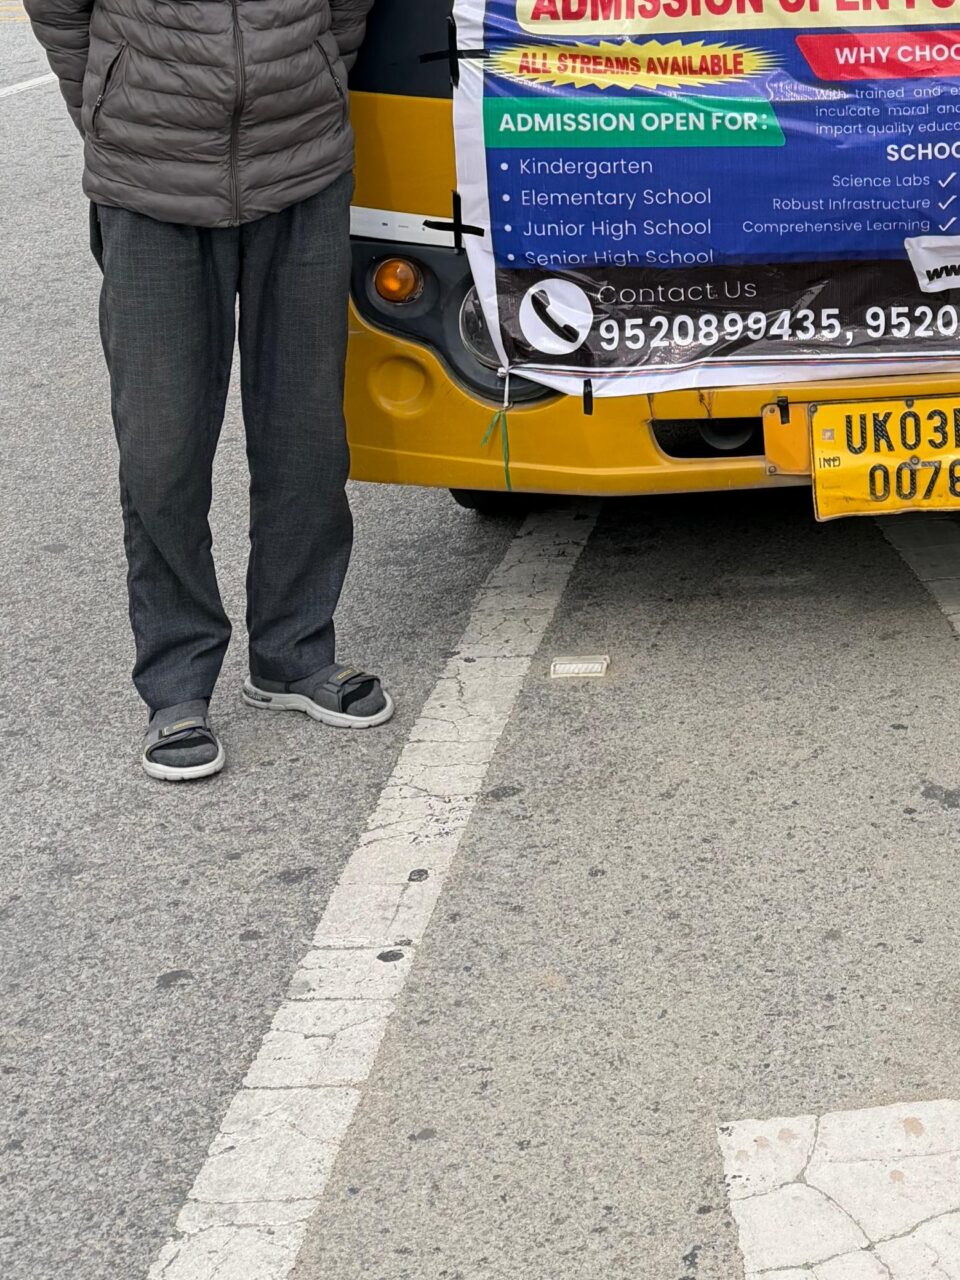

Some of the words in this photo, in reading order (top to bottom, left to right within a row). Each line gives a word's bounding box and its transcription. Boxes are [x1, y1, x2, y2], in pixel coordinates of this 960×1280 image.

[518, 52, 552, 74] ALL
[557, 53, 641, 76] STREAMS
[646, 53, 744, 75] AVAILABLE
[835, 46, 891, 65] WHY
[855, 87, 904, 99] trained
[914, 86, 941, 97] and
[815, 105, 880, 117] inculcate
[888, 104, 929, 116] moral
[499, 113, 636, 133] ADMISSION
[641, 112, 706, 132] OPEN
[815, 122, 862, 138] impart
[866, 121, 914, 136] quality
[519, 158, 653, 179] Kindergarten
[832, 174, 891, 187] Science
[896, 173, 930, 186] Labs
[521, 189, 637, 210] Elementary
[643, 187, 711, 205] School
[772, 198, 824, 210] Robust
[828, 197, 931, 210] Infrastructure
[523, 220, 585, 236] Junior
[592, 219, 636, 241] High
[643, 218, 711, 235] School
[742, 220, 862, 236] Comprehensive
[866, 219, 930, 232] Learning
[525, 251, 587, 266] Senior
[594, 250, 639, 267] High
[646, 248, 714, 264] School
[598, 283, 718, 304] Contact
[724, 280, 757, 299] Us
[599, 308, 854, 351] 9520899435,
